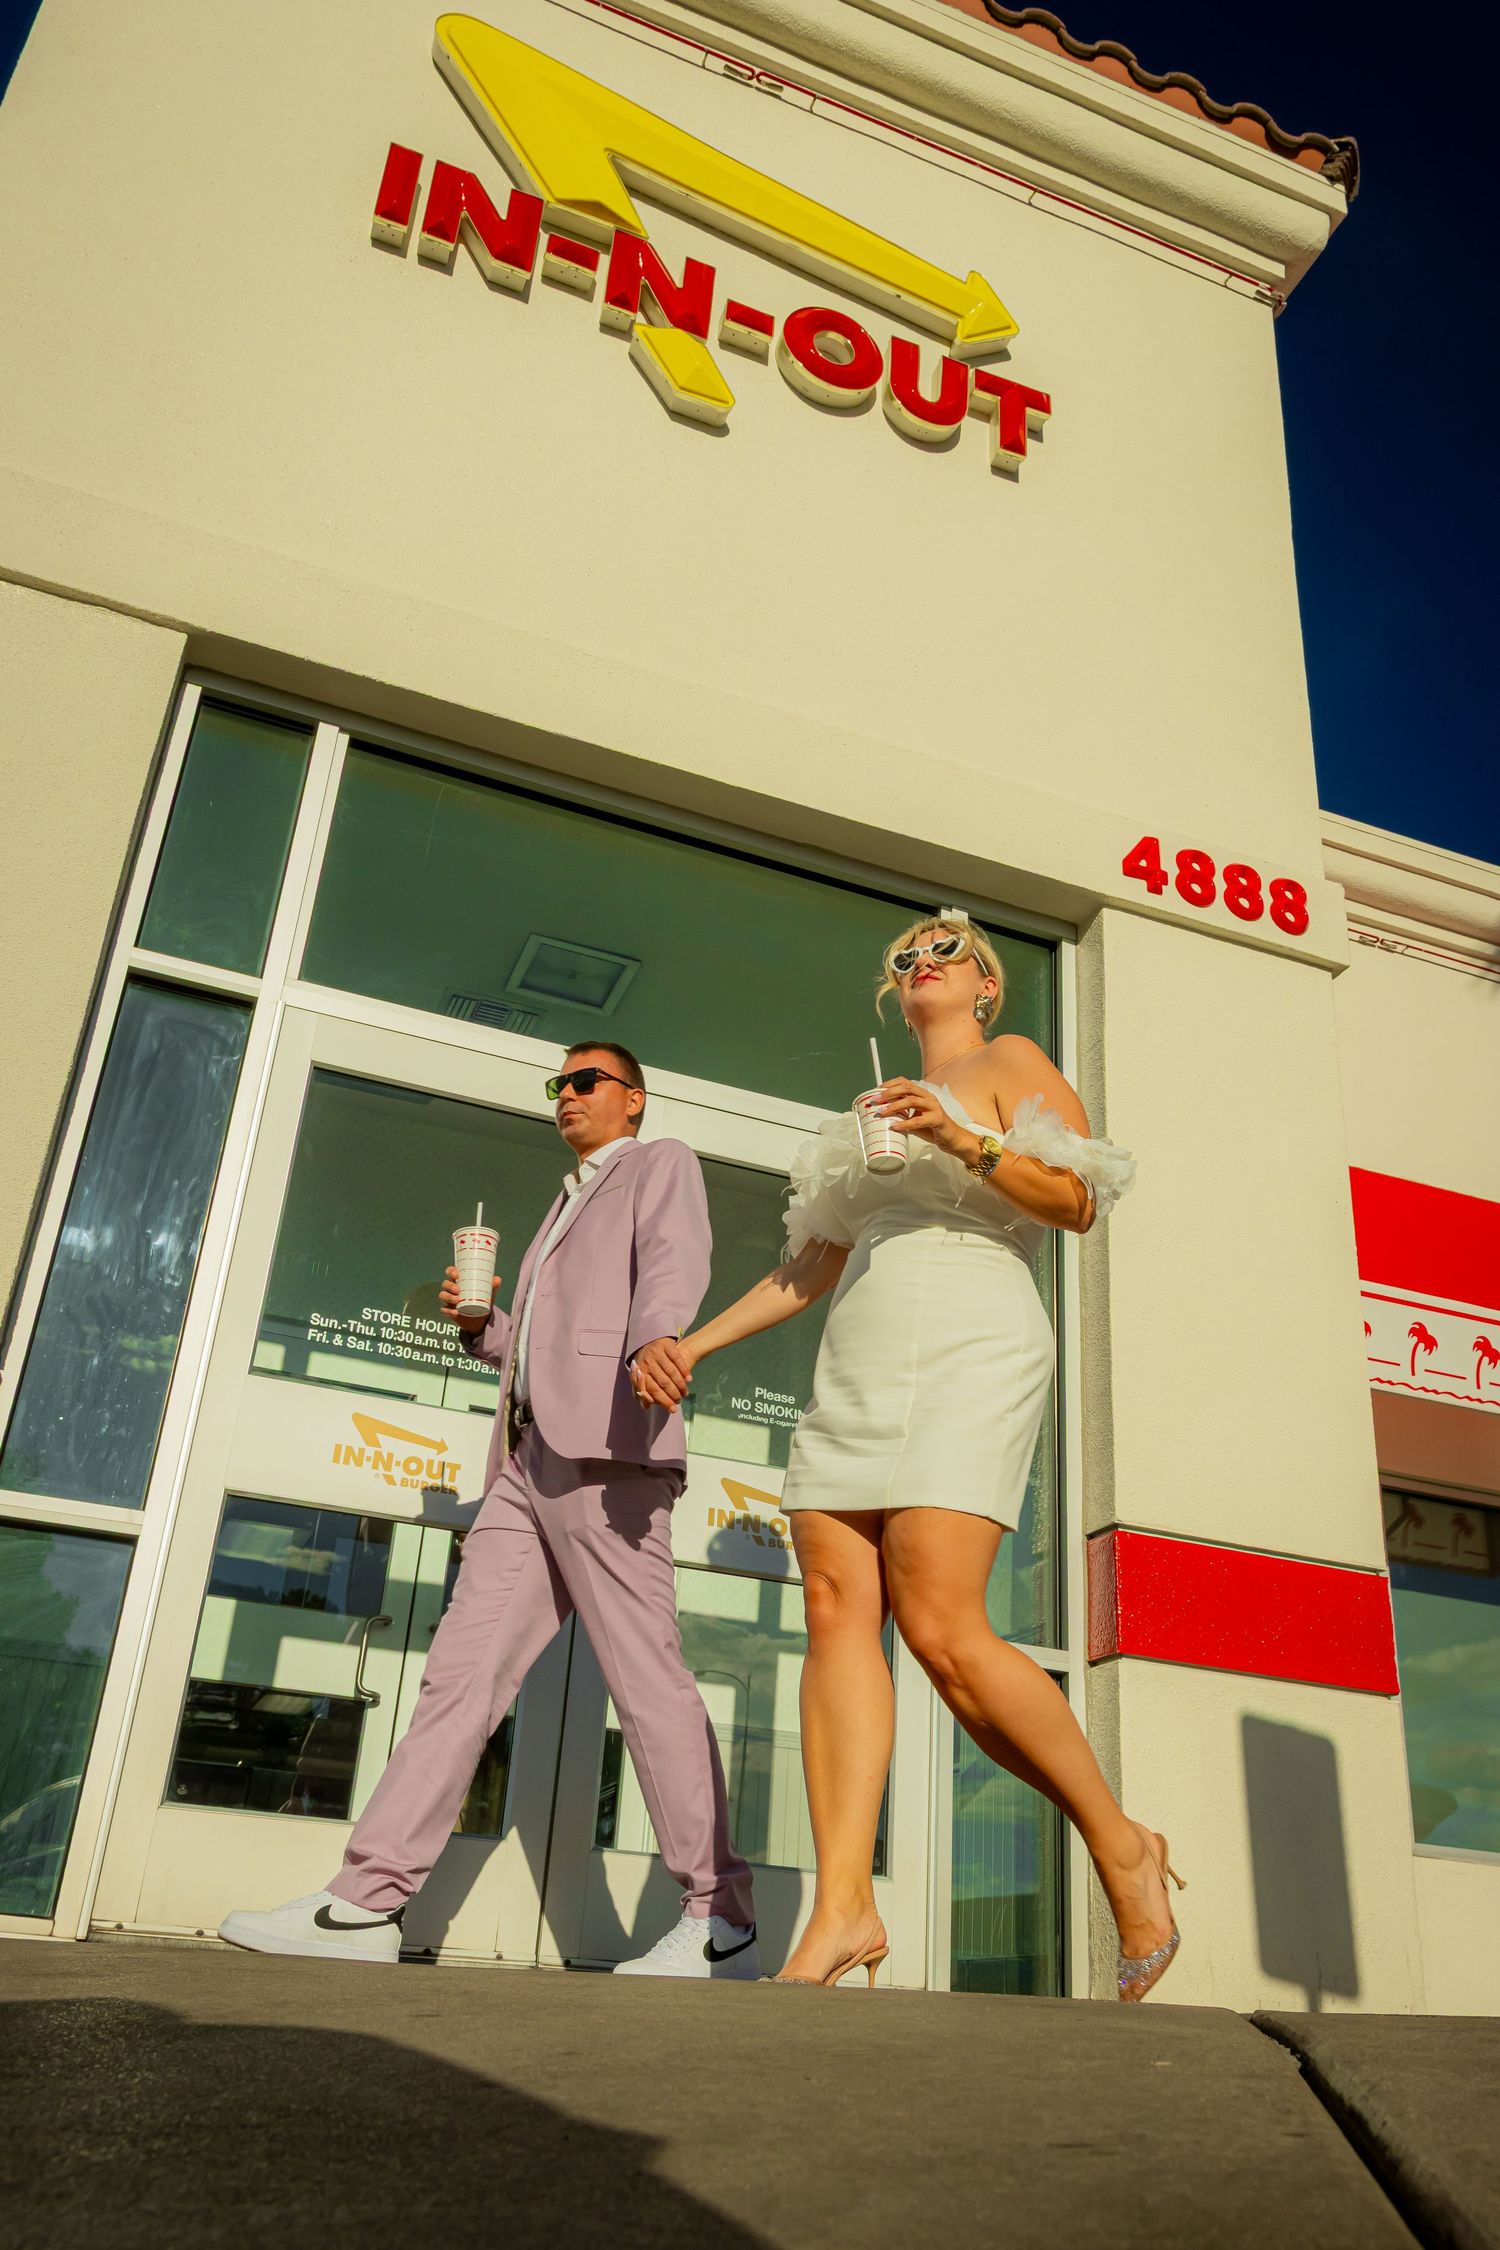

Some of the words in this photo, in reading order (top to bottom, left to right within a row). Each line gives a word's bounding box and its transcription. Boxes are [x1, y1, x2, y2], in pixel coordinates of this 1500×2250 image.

[373, 142, 1052, 458] IN-N-OUT
[1122, 836, 1310, 937] 4888
[309, 1312, 377, 1337] Sun.-Thu.
[443, 1339, 456, 1352] to
[361, 1307, 412, 1328] STORE
[307, 1328, 330, 1344] Fri.
[332, 1333, 344, 1347] &
[346, 1336, 374, 1352] Sat.
[441, 1354, 455, 1367] to
[731, 1397, 752, 1411] NO
[755, 1386, 796, 1405] Please
[331, 1443, 462, 1483] IN-N-OUT
[400, 1477, 458, 1496] BURGER
[707, 1507, 788, 1537] IN-N-O
[768, 1538, 794, 1551] BUR
